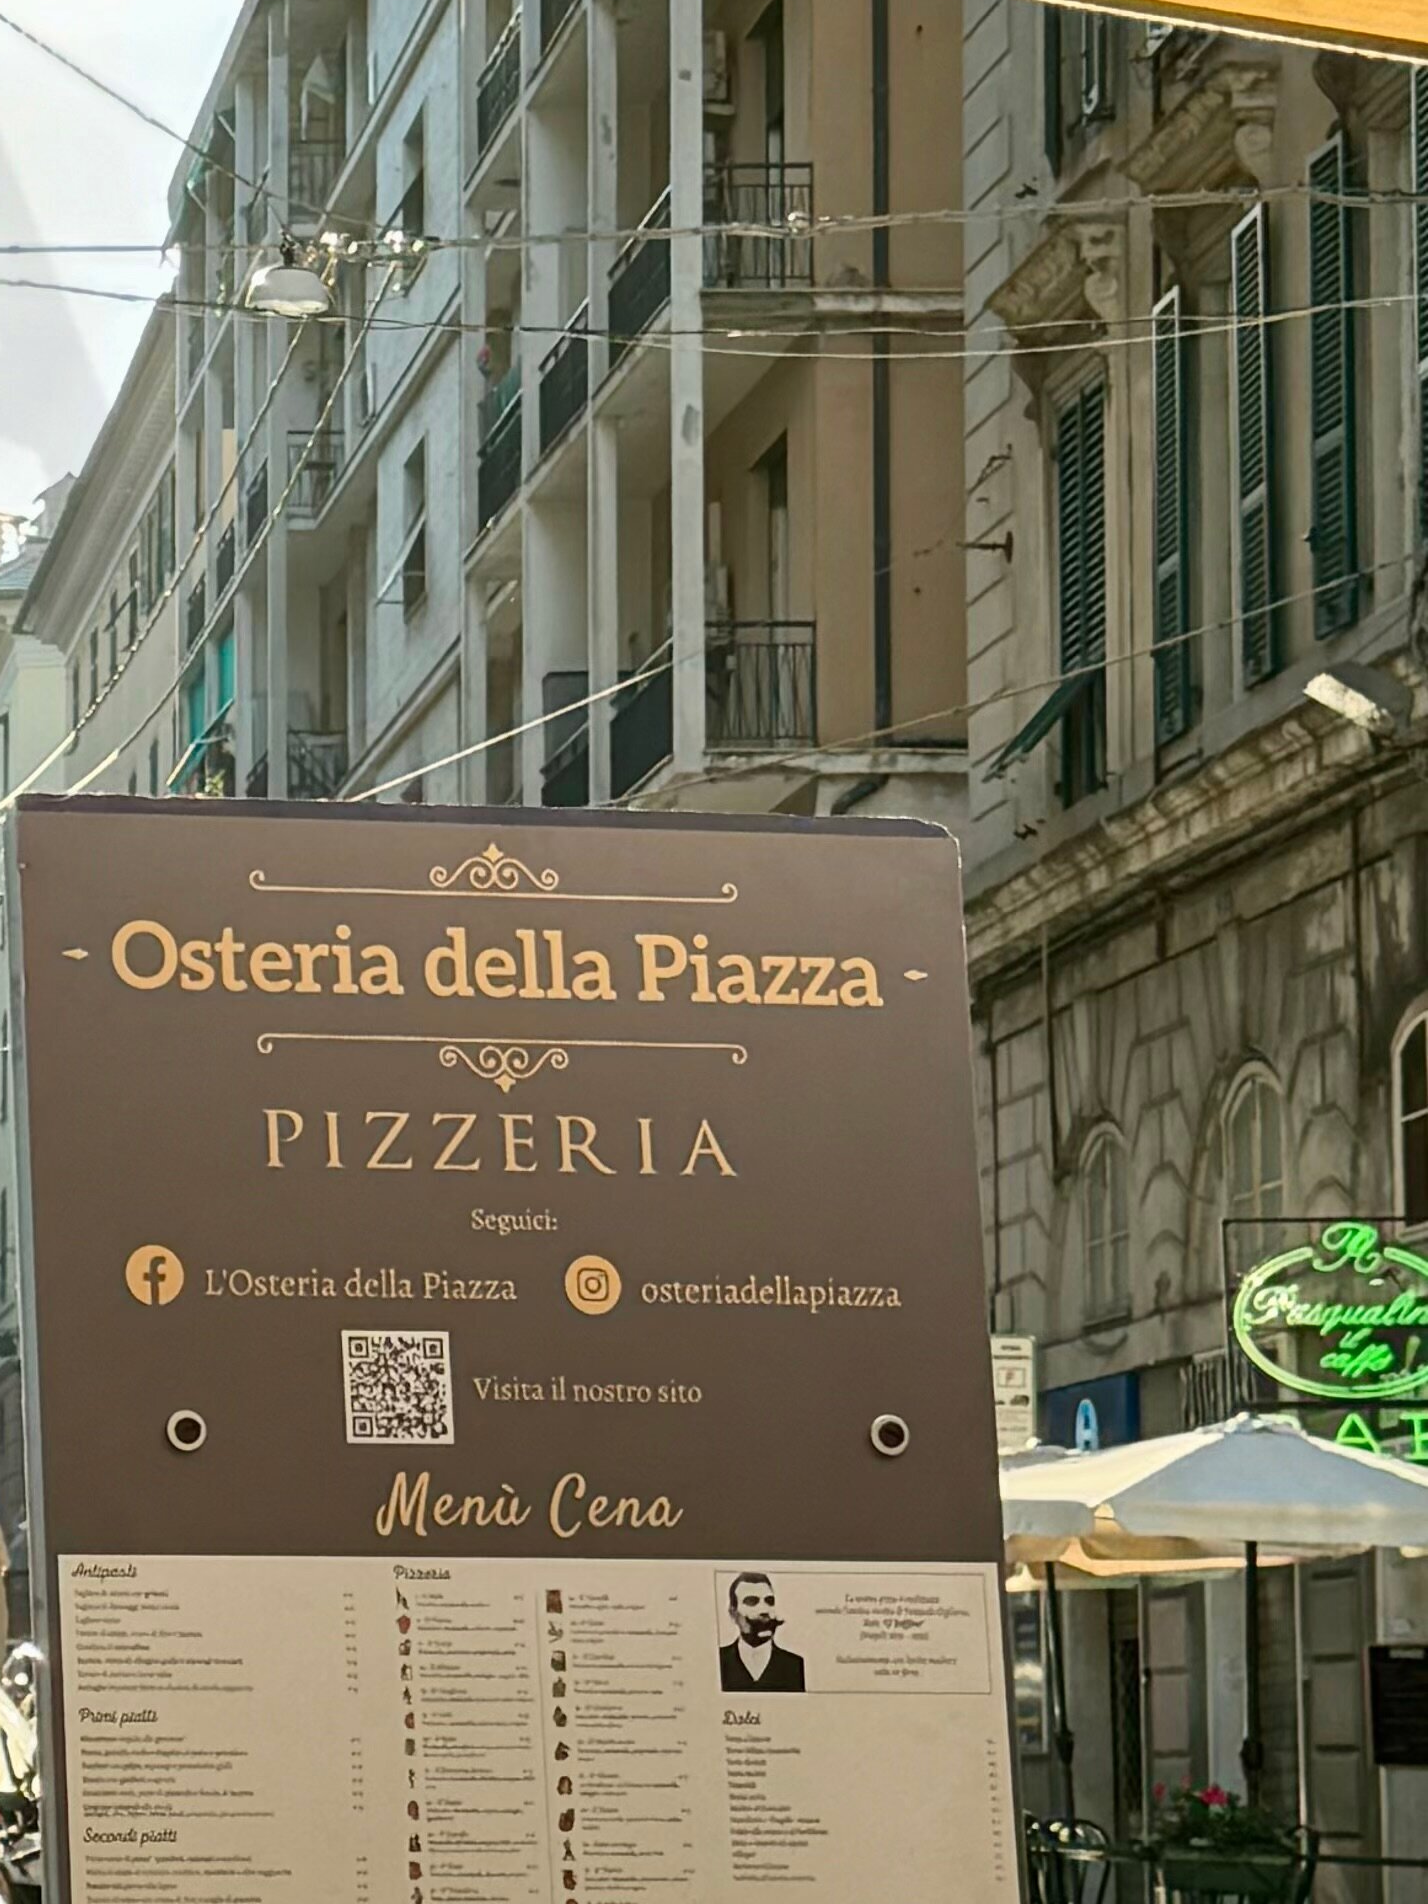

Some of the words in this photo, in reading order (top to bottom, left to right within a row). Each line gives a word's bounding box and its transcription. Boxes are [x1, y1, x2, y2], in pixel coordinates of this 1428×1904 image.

[111, 919, 404, 997] Osteria
[425, 930, 616, 1001] della
[638, 934, 884, 1009] Piazza
[262, 1109, 738, 1178] PIZZERIA
[469, 1208, 558, 1237] Seguici:
[205, 1270, 336, 1300] L'Osteria
[344, 1270, 414, 1301] della
[423, 1271, 517, 1303] Piazza
[640, 1274, 902, 1313] osteriadellapiazza
[473, 1375, 543, 1404] Visita
[551, 1376, 565, 1404] il
[571, 1379, 650, 1404] nostro
[656, 1377, 703, 1404] sito
[376, 1472, 530, 1537] Menù
[550, 1473, 682, 1537] Cena
[71, 1562, 138, 1583] Antipasti
